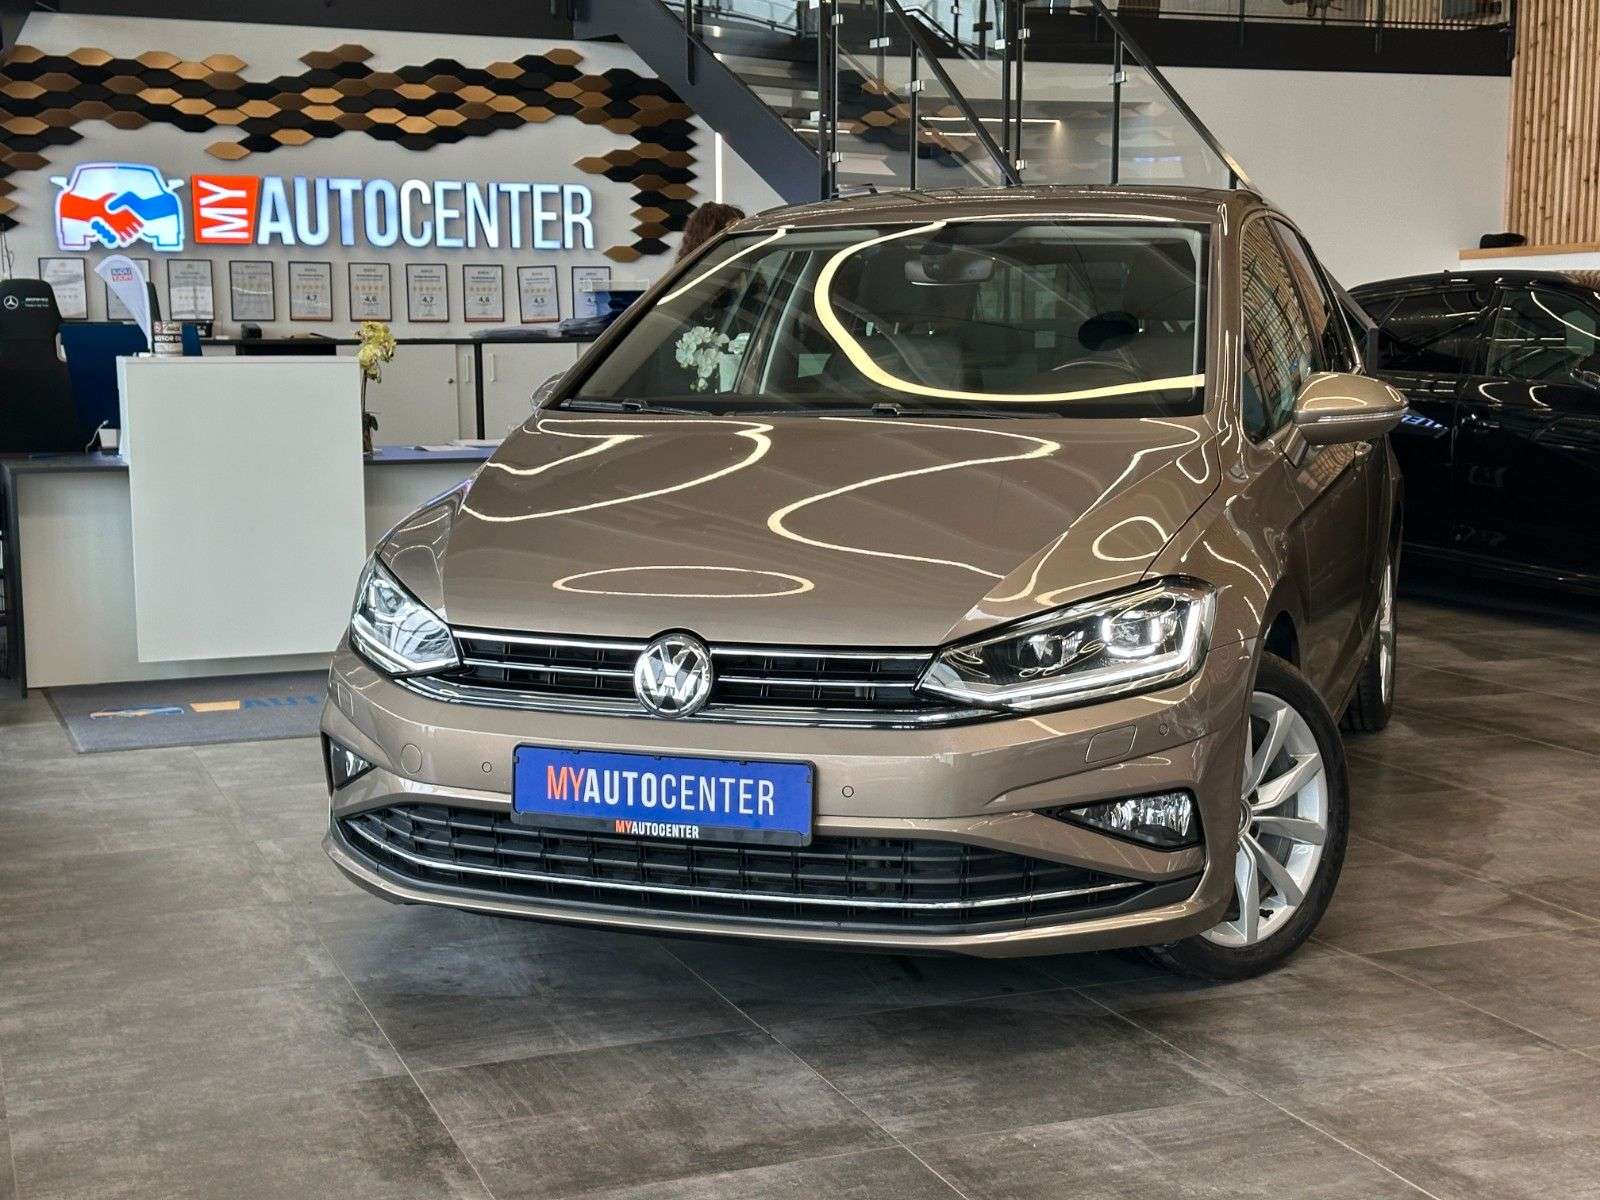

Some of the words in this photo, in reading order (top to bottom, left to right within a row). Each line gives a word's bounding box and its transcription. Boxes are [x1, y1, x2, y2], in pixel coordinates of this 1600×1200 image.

[197, 179, 250, 239] MY
[257, 176, 594, 249] AUTOCENTER
[546, 765, 775, 816] MYAUTOCENTER
[615, 819, 700, 839] MYAUTOCENTER
